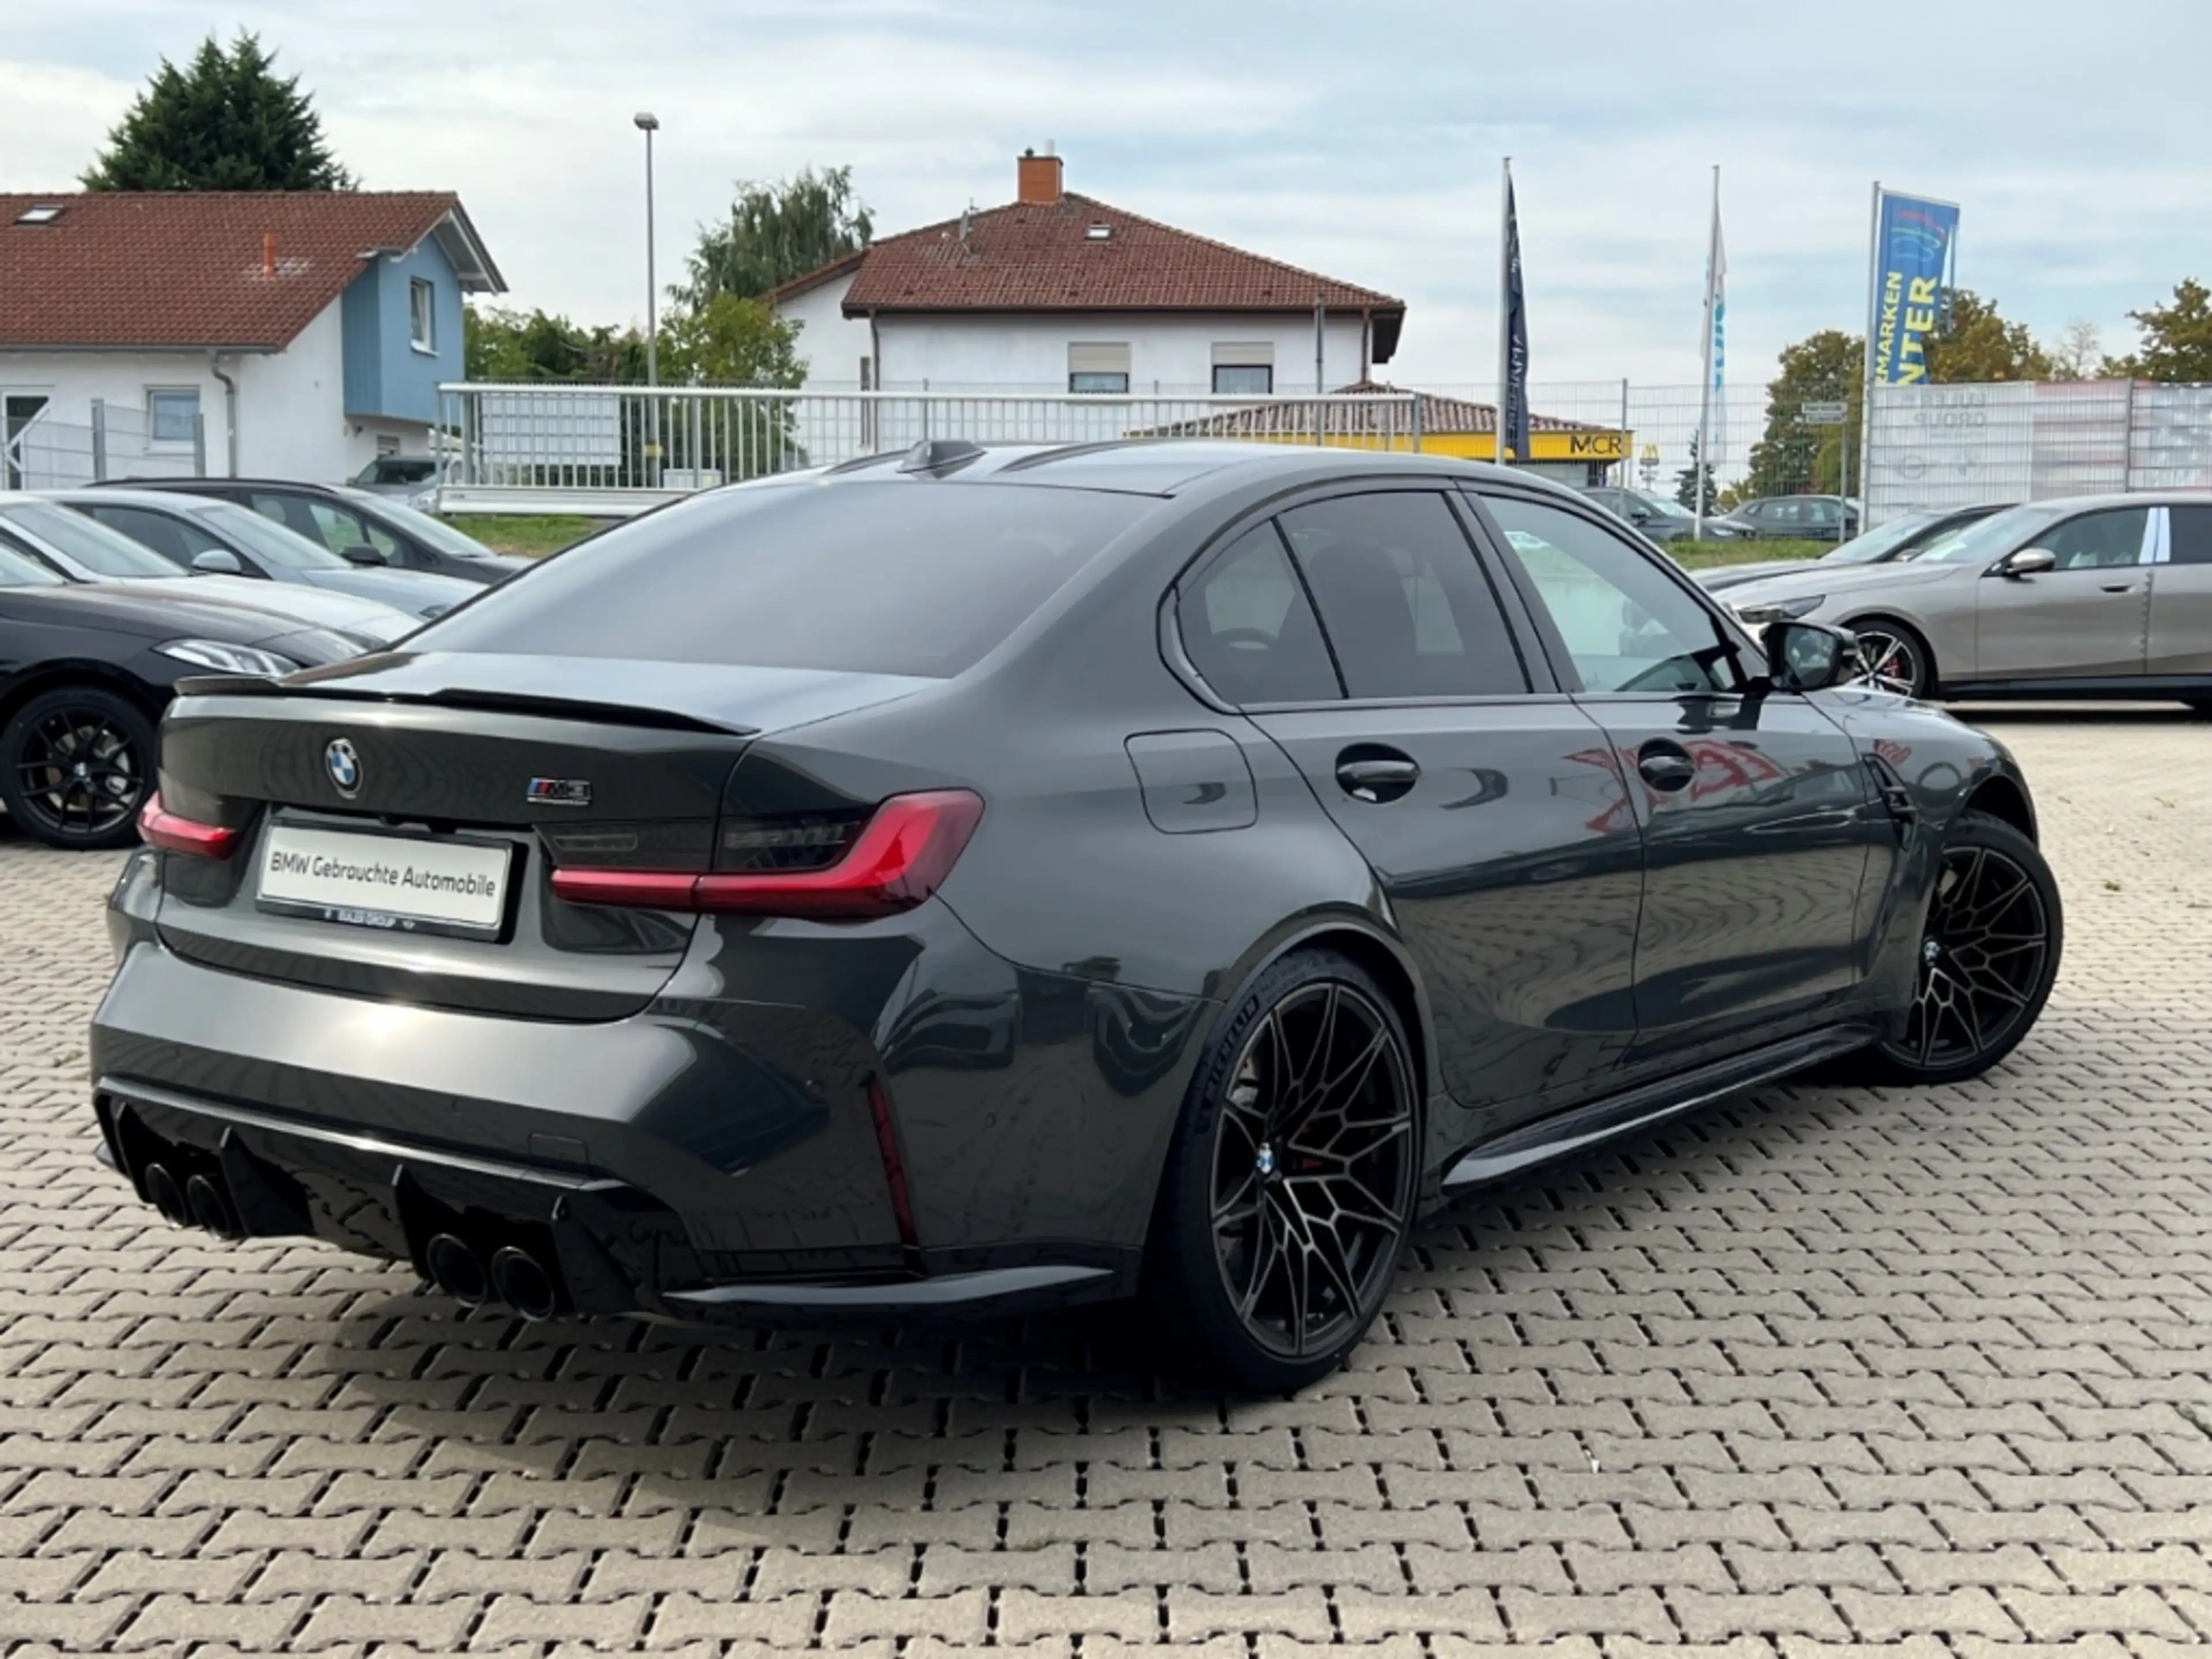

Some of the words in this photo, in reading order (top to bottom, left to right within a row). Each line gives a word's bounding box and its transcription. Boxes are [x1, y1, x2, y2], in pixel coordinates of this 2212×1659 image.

[1570, 435, 1622, 454] MCR
[271, 851, 310, 874] BMW
[313, 856, 398, 885] Gebrauchte
[402, 866, 496, 897] Automobile
